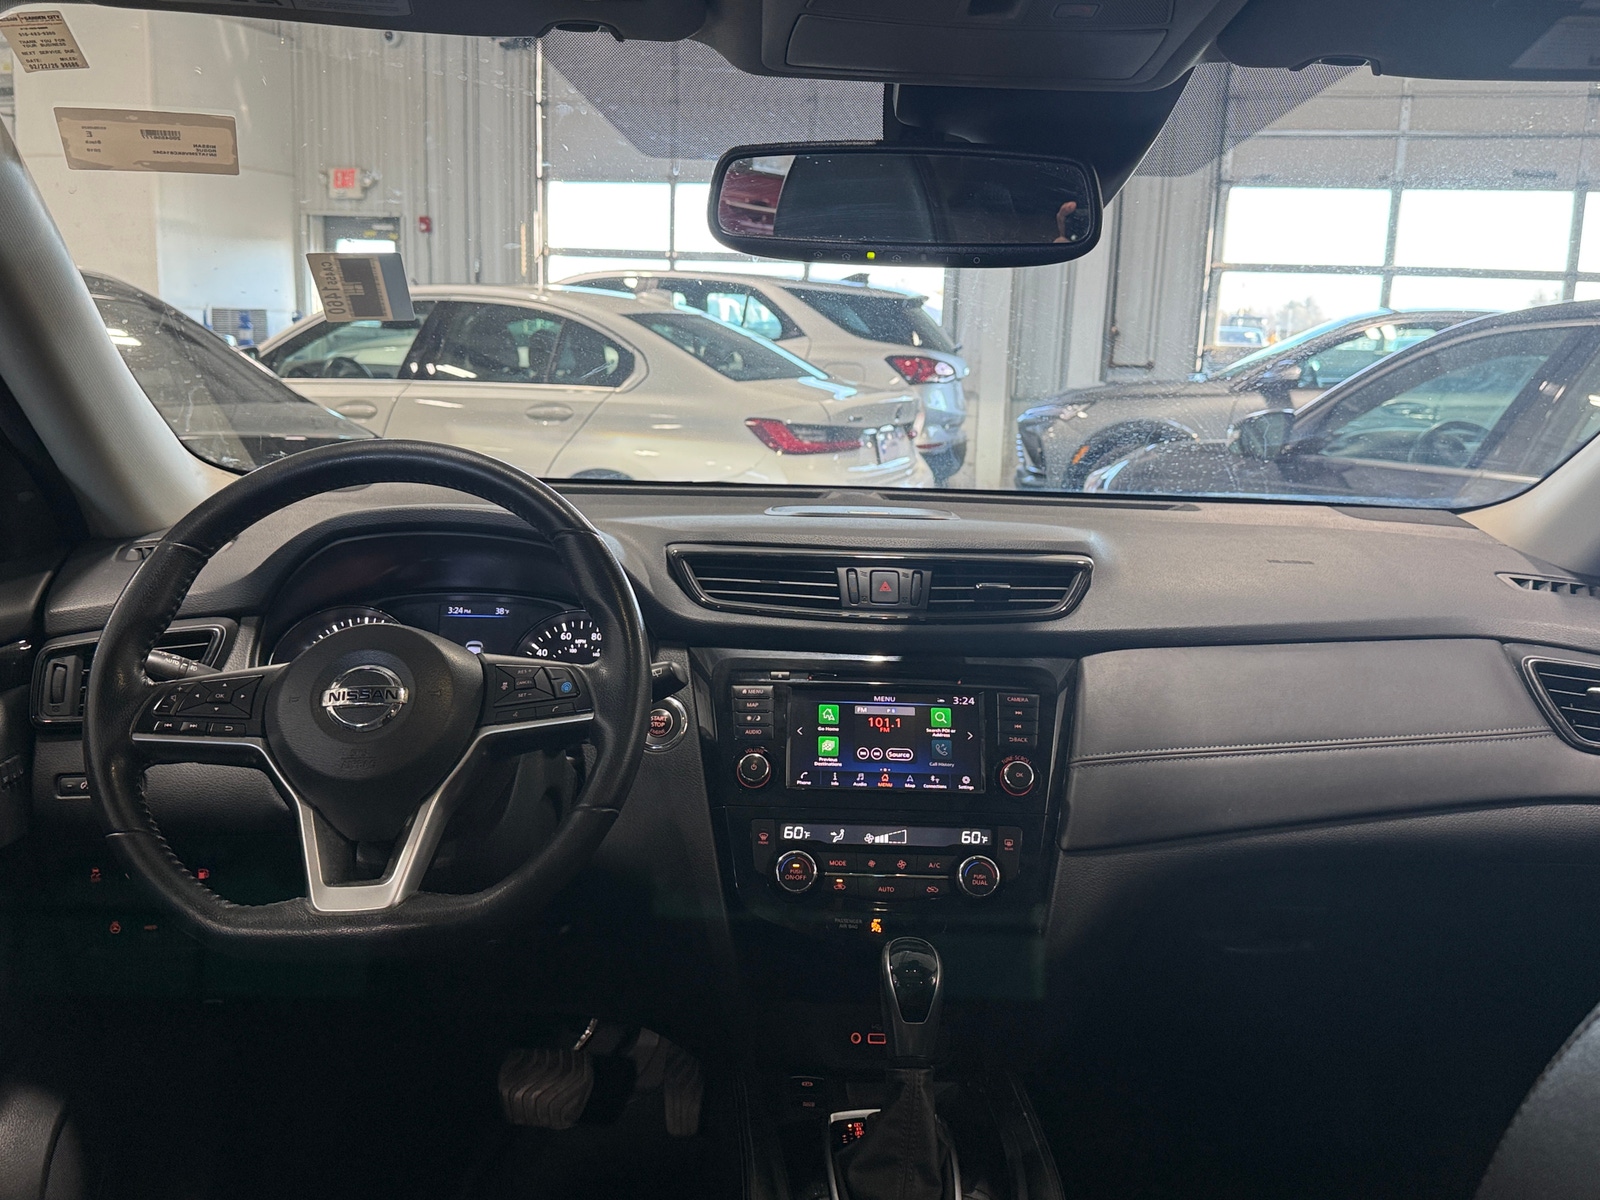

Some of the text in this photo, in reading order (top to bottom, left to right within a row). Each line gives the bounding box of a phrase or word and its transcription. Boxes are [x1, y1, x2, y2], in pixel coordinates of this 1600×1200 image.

[591, 633, 602, 641] 80
[536, 649, 548, 657] 40
[329, 689, 398, 702] NISSAN
[953, 696, 975, 705] 3:24
[868, 717, 901, 728] 101.1
